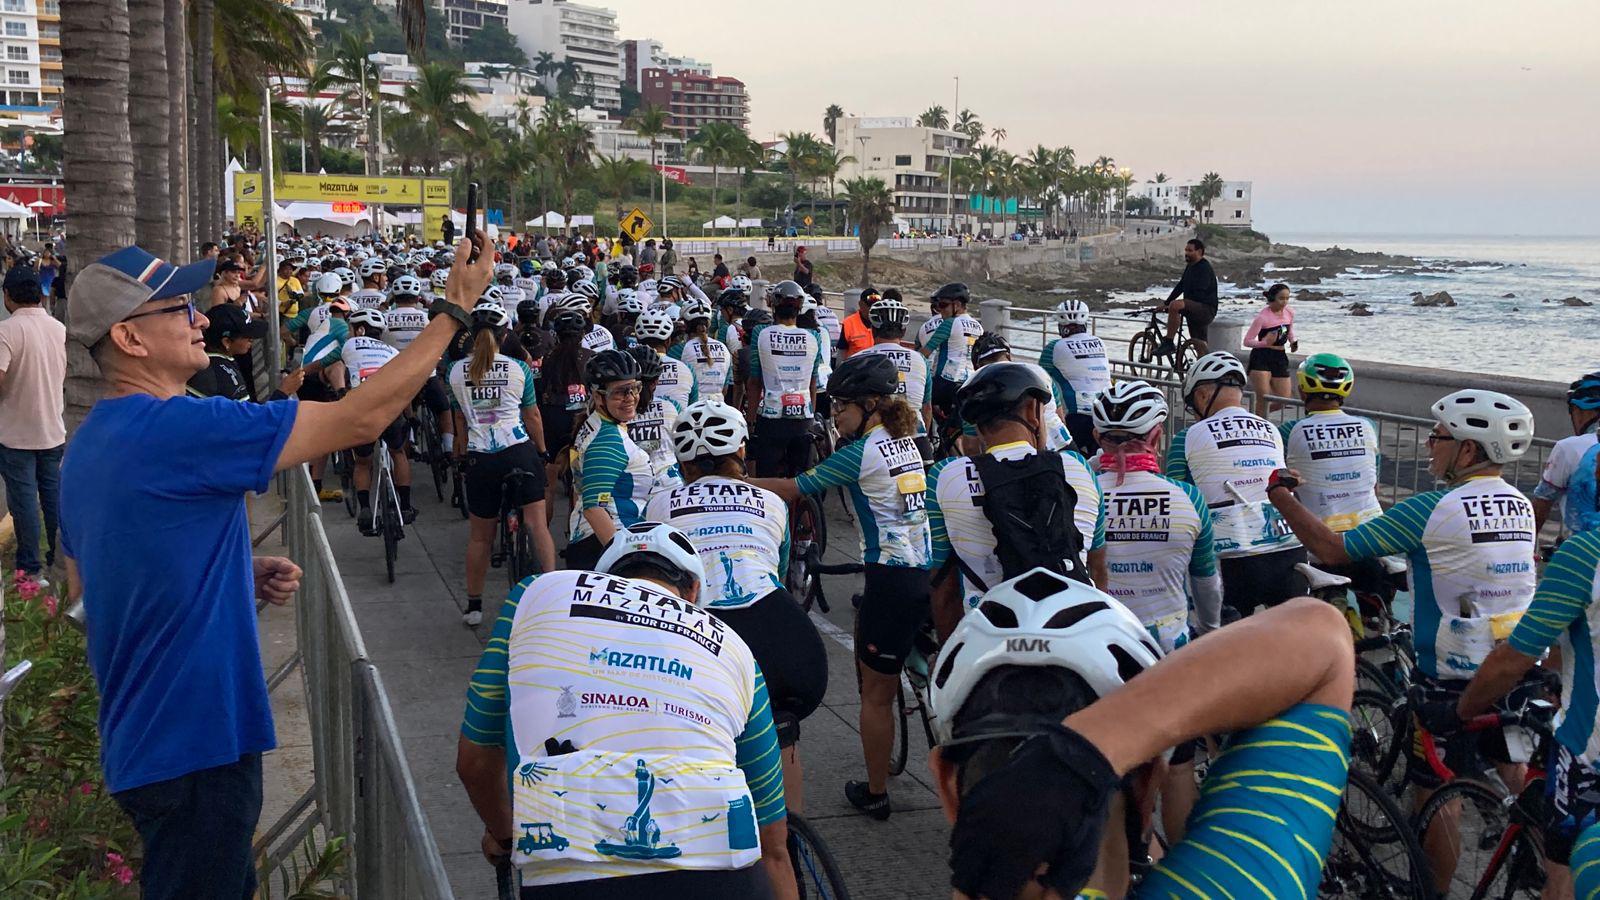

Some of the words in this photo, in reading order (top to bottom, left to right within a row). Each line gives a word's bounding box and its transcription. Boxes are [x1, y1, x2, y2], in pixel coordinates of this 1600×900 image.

[319, 182, 359, 192] MAZATLÁN
[473, 387, 500, 399] 1191
[569, 393, 585, 403] 561
[786, 405, 802, 416] 503
[630, 426, 660, 442] 1171
[905, 493, 926, 511] 124
[1107, 516, 1170, 529] ZATLÁN
[626, 614, 658, 627] TOUR
[660, 621, 675, 631] DE
[676, 625, 717, 652] FRANCE
[589, 647, 693, 680] MAZATLÁN
[581, 693, 650, 708] SINALOA
[664, 702, 711, 726] TURISMO
